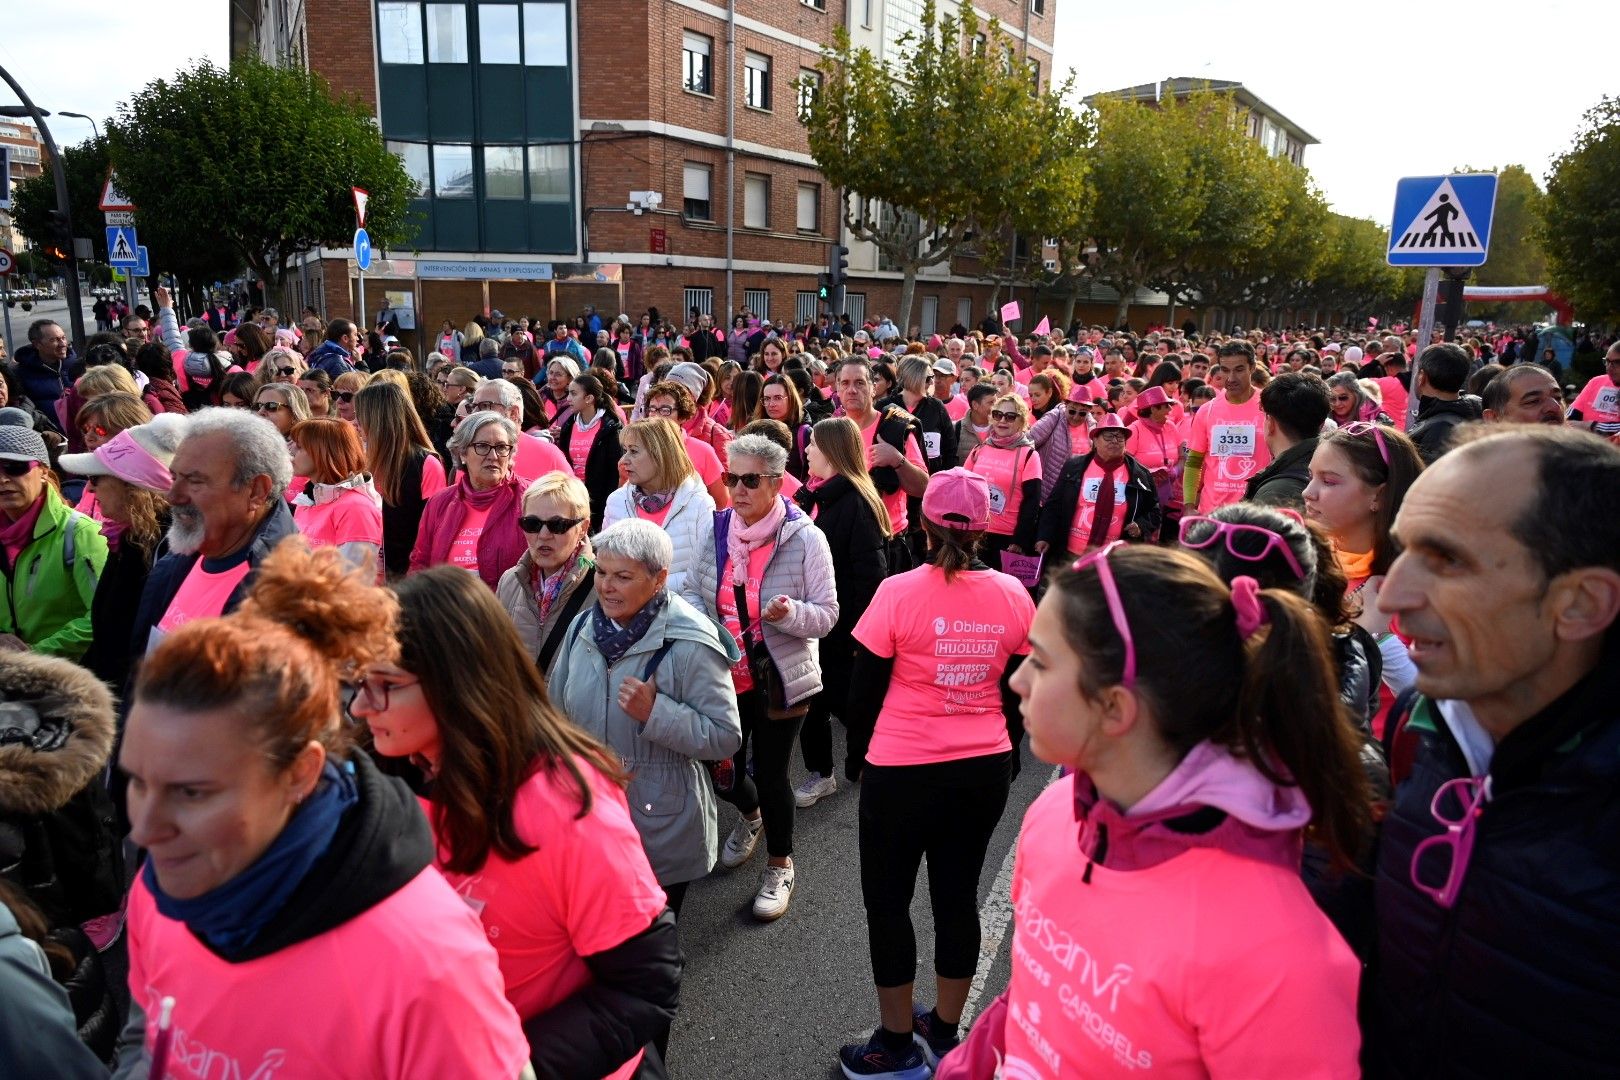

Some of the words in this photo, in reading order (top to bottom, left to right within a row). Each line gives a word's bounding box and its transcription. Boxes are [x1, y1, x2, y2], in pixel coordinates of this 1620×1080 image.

[423, 264, 468, 273] INTERVENCIÓN
[479, 266, 501, 274] ARMAS
[503, 266, 508, 274] Y
[508, 267, 545, 275] EXPLOSIVOS
[1220, 435, 1249, 444] 3333
[953, 620, 1005, 634] Oblanca
[938, 643, 994, 654] HIJOLUSA
[937, 663, 991, 672] DESATASCOS
[934, 671, 987, 686] ZAPICO
[1058, 984, 1153, 1069] CAROBELS
